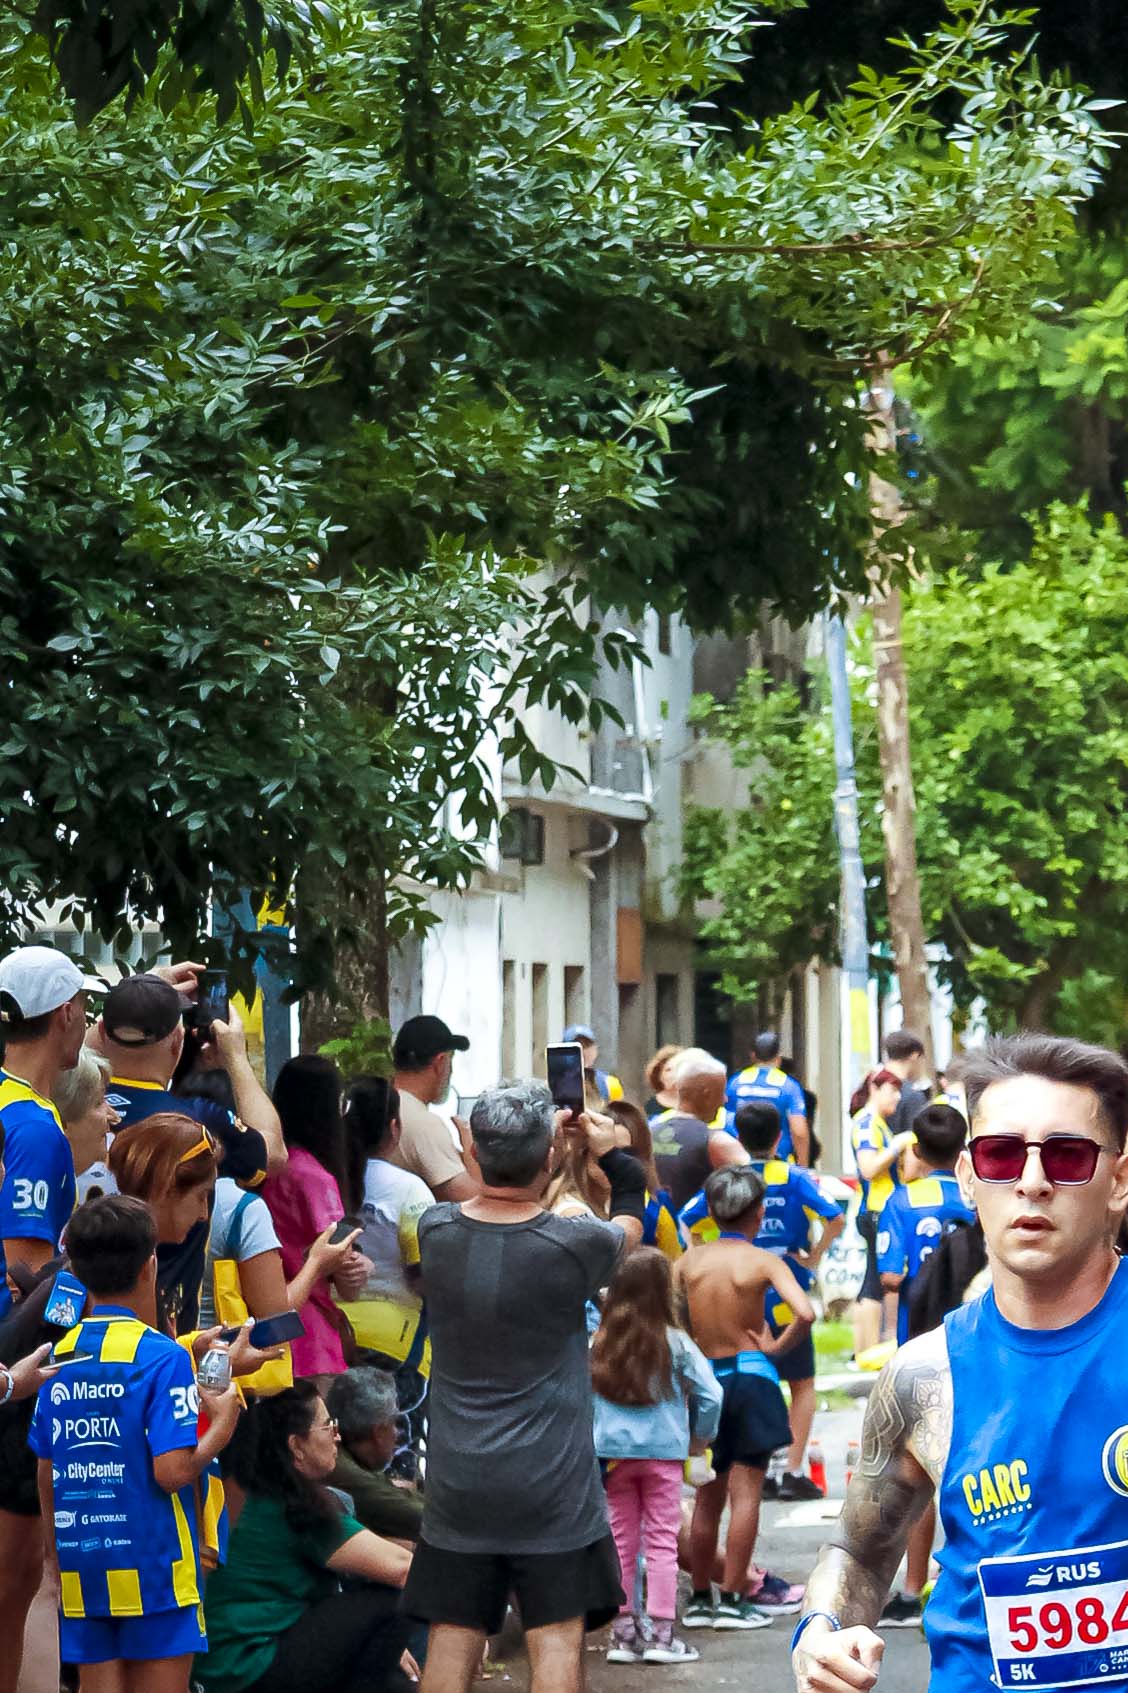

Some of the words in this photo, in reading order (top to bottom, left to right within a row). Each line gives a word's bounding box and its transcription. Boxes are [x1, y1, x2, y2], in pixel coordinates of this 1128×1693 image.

[12, 1177, 49, 1211] 30
[73, 1381, 125, 1400] Macro
[65, 1417, 120, 1440] PORTA
[67, 1461, 125, 1483] CityCenter
[962, 1459, 1031, 1517] CARC
[1056, 1561, 1101, 1583] RUS
[1010, 1663, 1037, 1681] 5K
